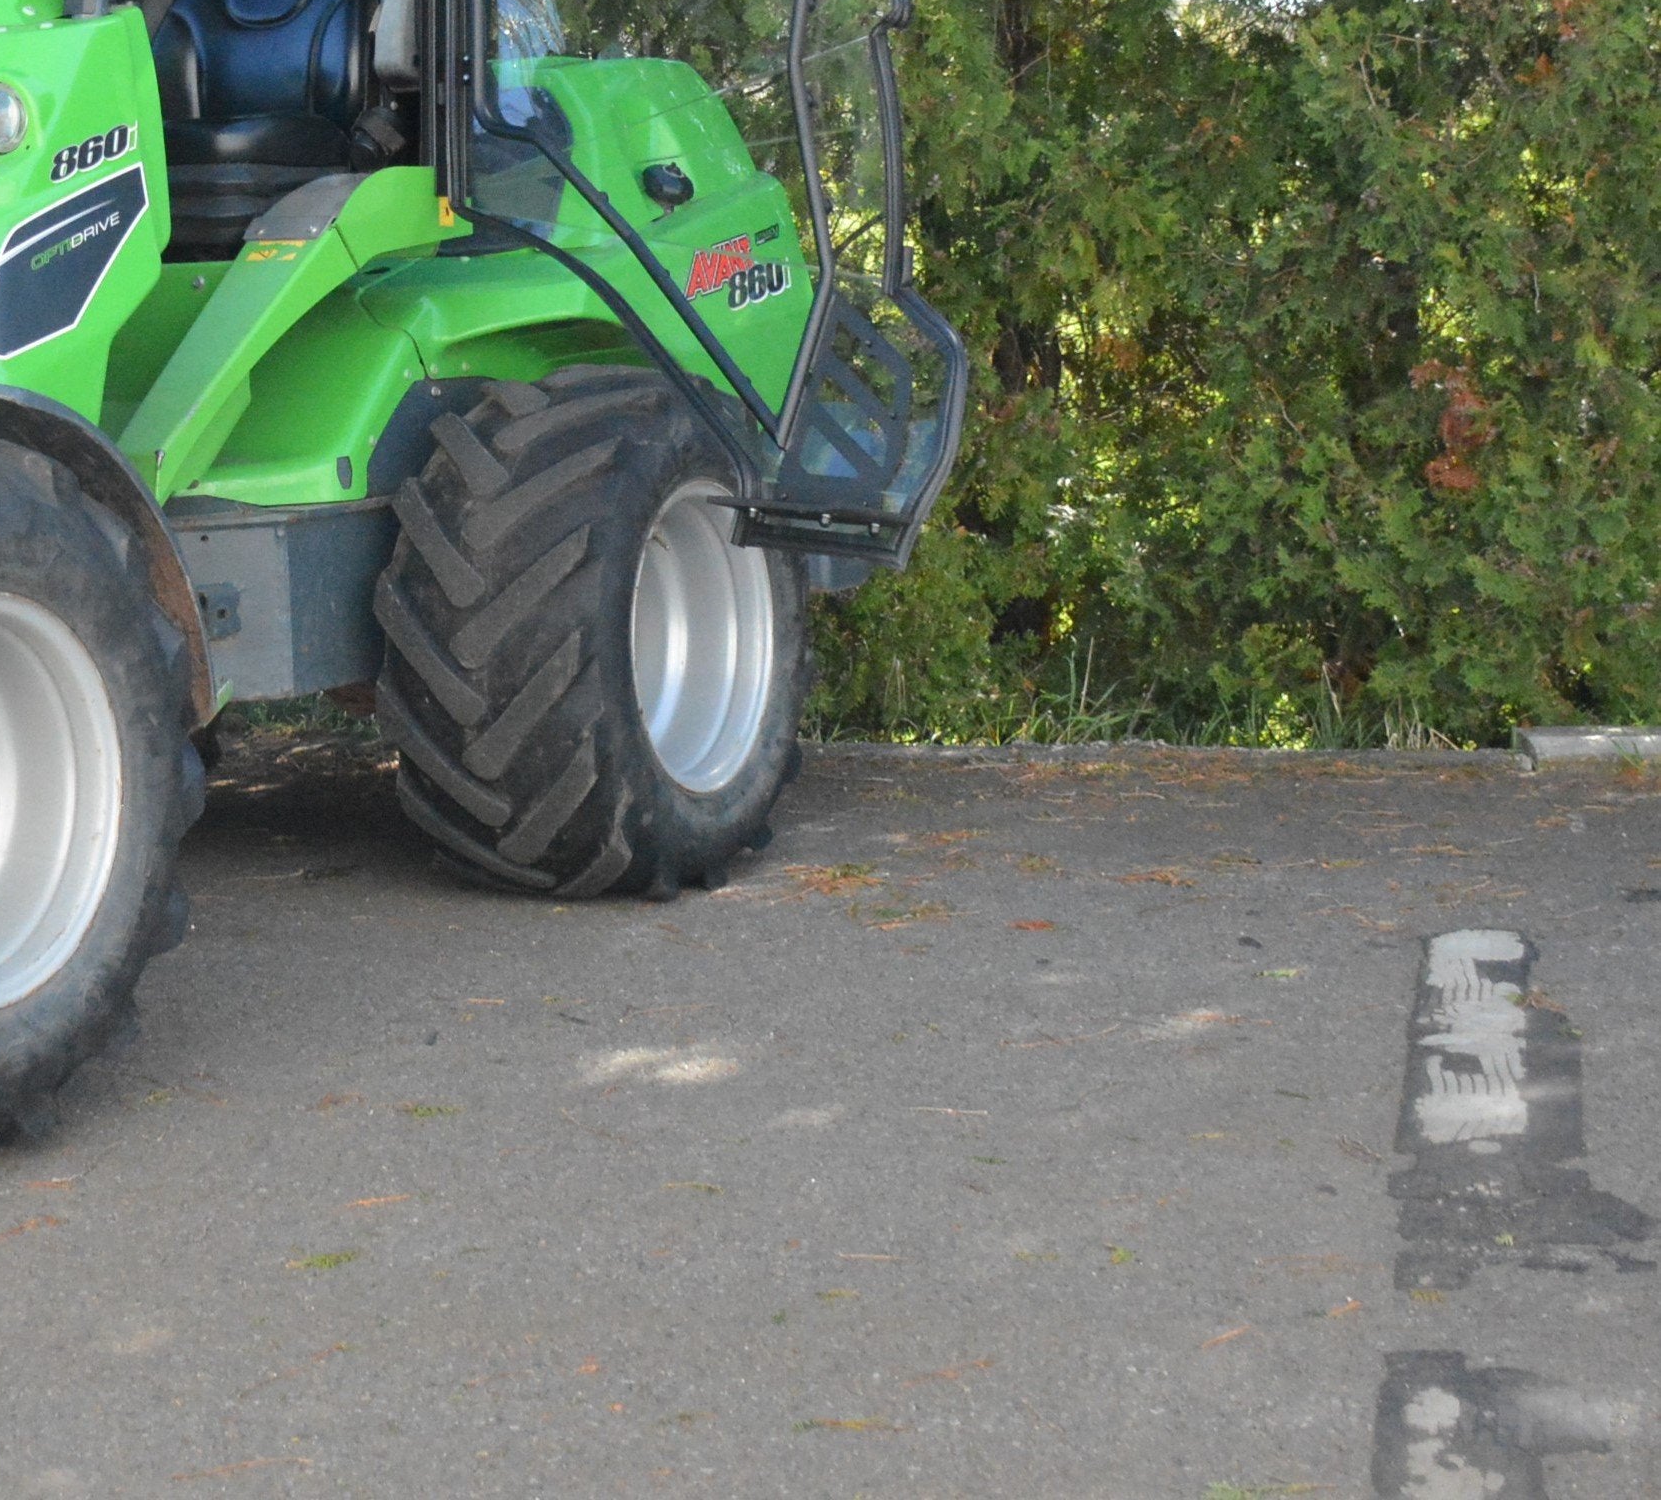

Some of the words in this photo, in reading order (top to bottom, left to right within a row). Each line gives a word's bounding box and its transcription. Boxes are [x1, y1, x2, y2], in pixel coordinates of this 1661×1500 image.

[50, 120, 138, 183] 860i
[31, 211, 120, 270] OPTIDRIVE
[728, 257, 791, 310] 860i
